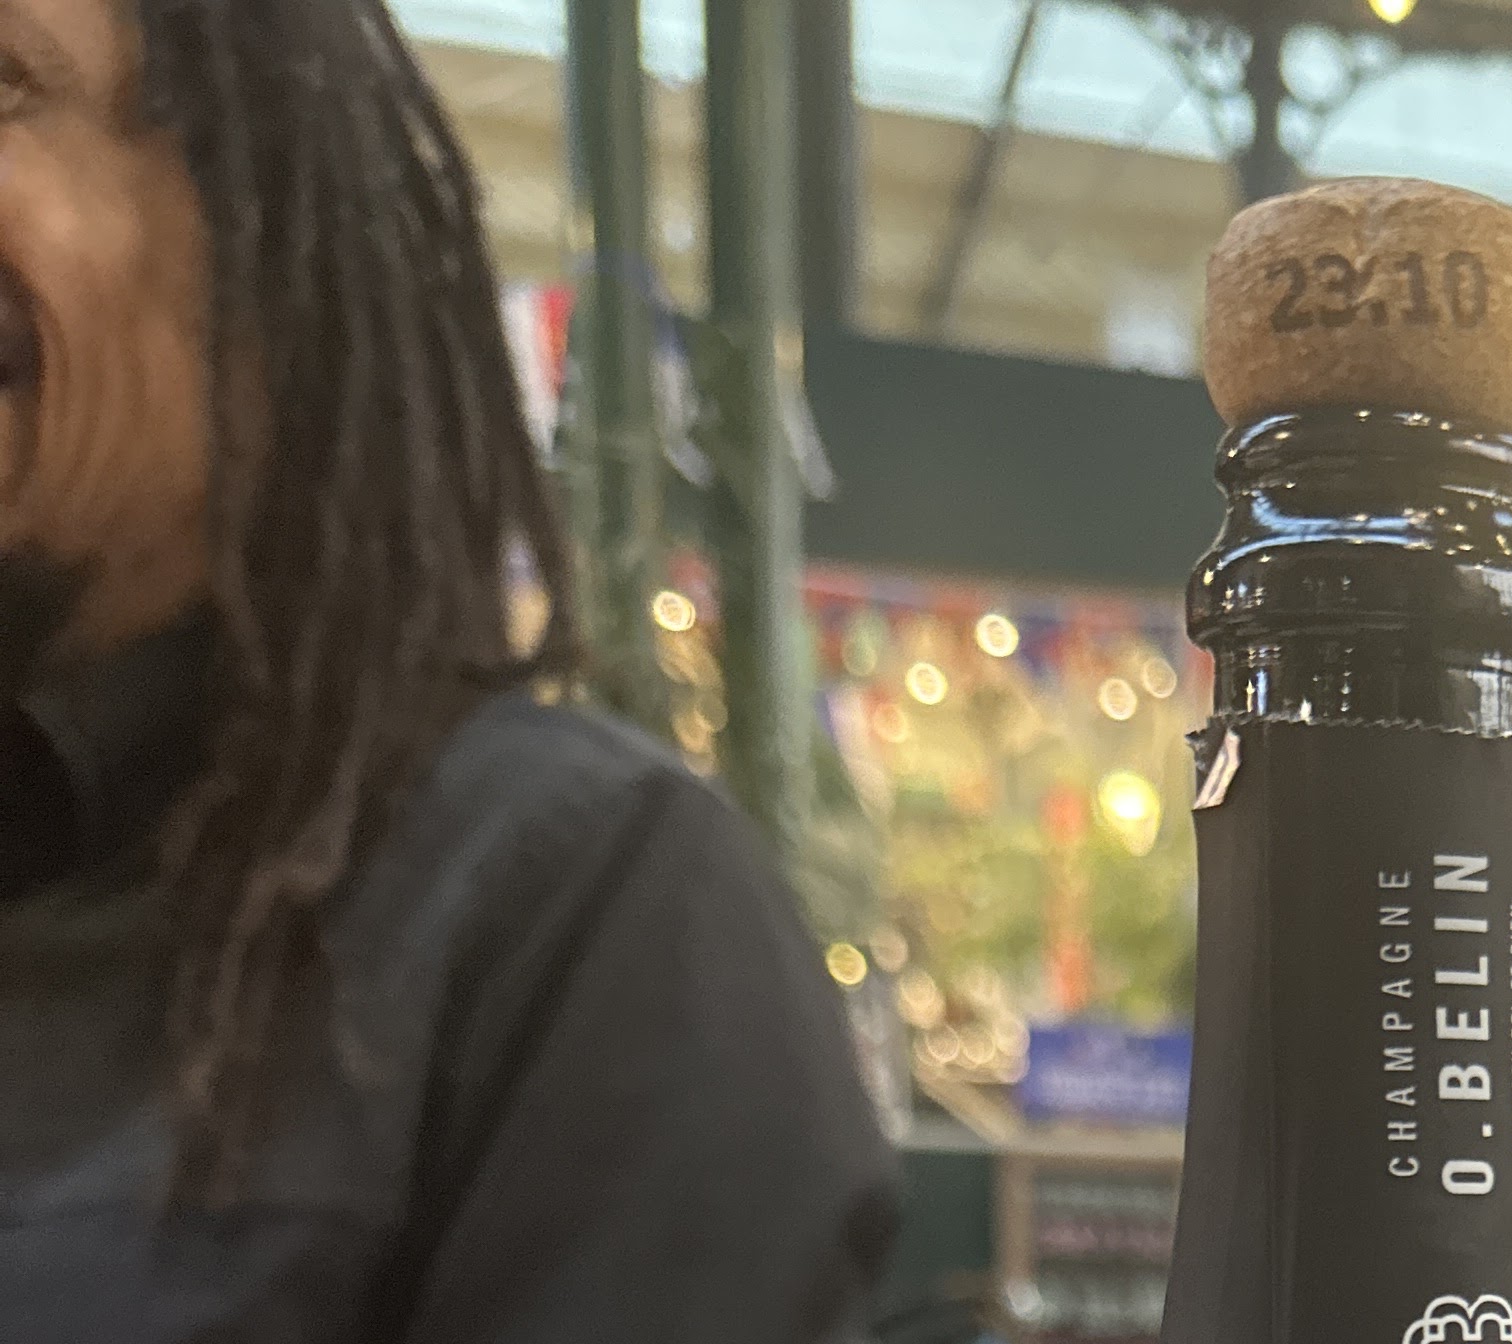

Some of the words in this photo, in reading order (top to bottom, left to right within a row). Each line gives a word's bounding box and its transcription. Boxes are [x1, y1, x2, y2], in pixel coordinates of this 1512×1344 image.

[1265, 248, 1489, 333] 23.10
[1378, 869, 1420, 1177] CHAMPAGNE
[1433, 854, 1495, 1195] O.BELIN
